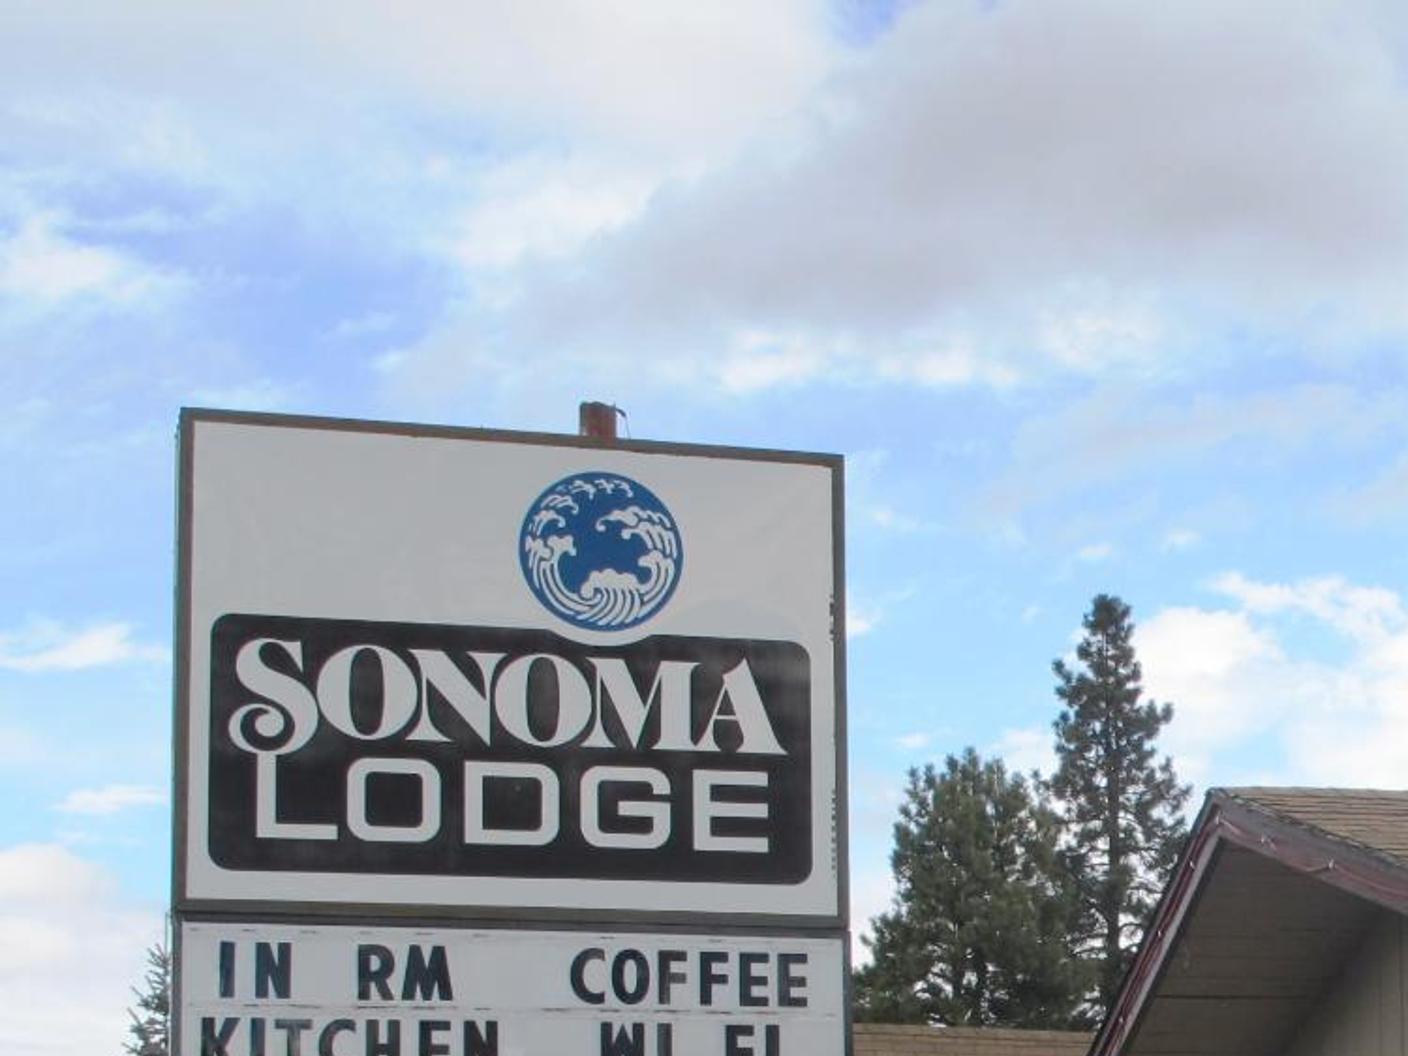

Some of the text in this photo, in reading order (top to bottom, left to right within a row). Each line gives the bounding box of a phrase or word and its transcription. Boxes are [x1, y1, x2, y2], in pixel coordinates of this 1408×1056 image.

[228, 637, 788, 756] SONOMA
[256, 752, 770, 854] LODGE
[219, 941, 808, 1008] IN RM COFFEE
